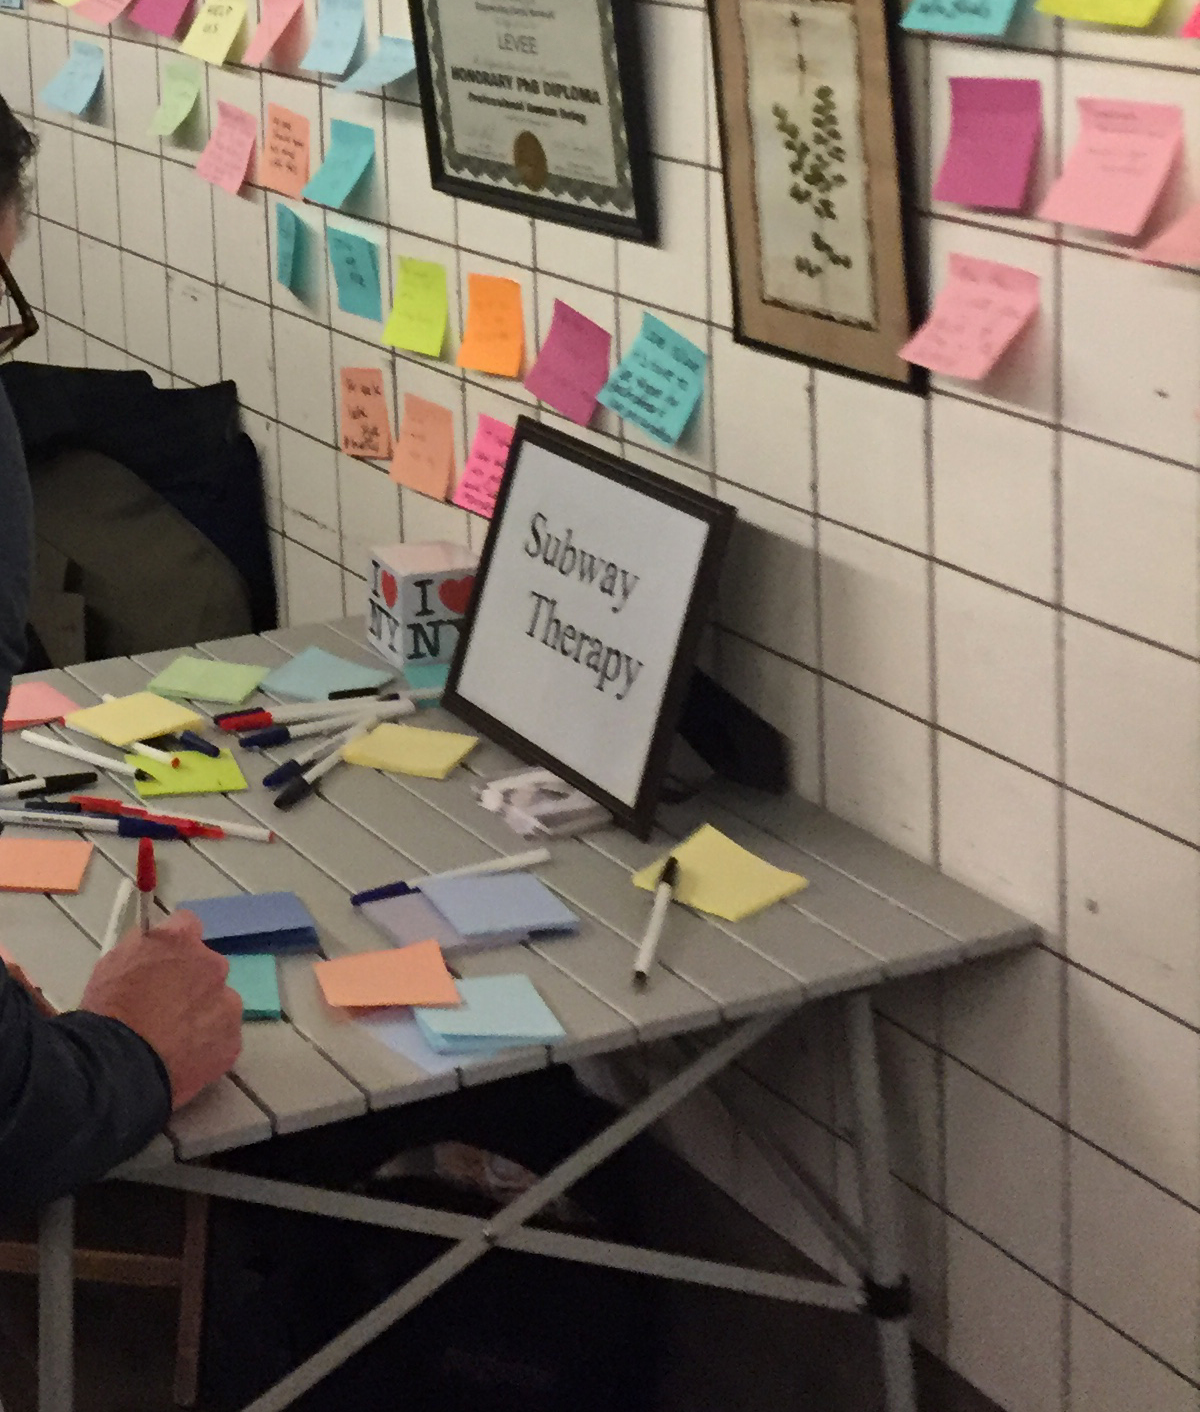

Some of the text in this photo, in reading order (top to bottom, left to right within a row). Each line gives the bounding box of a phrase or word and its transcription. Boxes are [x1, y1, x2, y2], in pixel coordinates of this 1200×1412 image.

[497, 32, 538, 55] LEVEE
[523, 511, 641, 614] Subway
[368, 597, 400, 653] NY
[413, 578, 436, 617] I
[525, 590, 645, 701] Therapy
